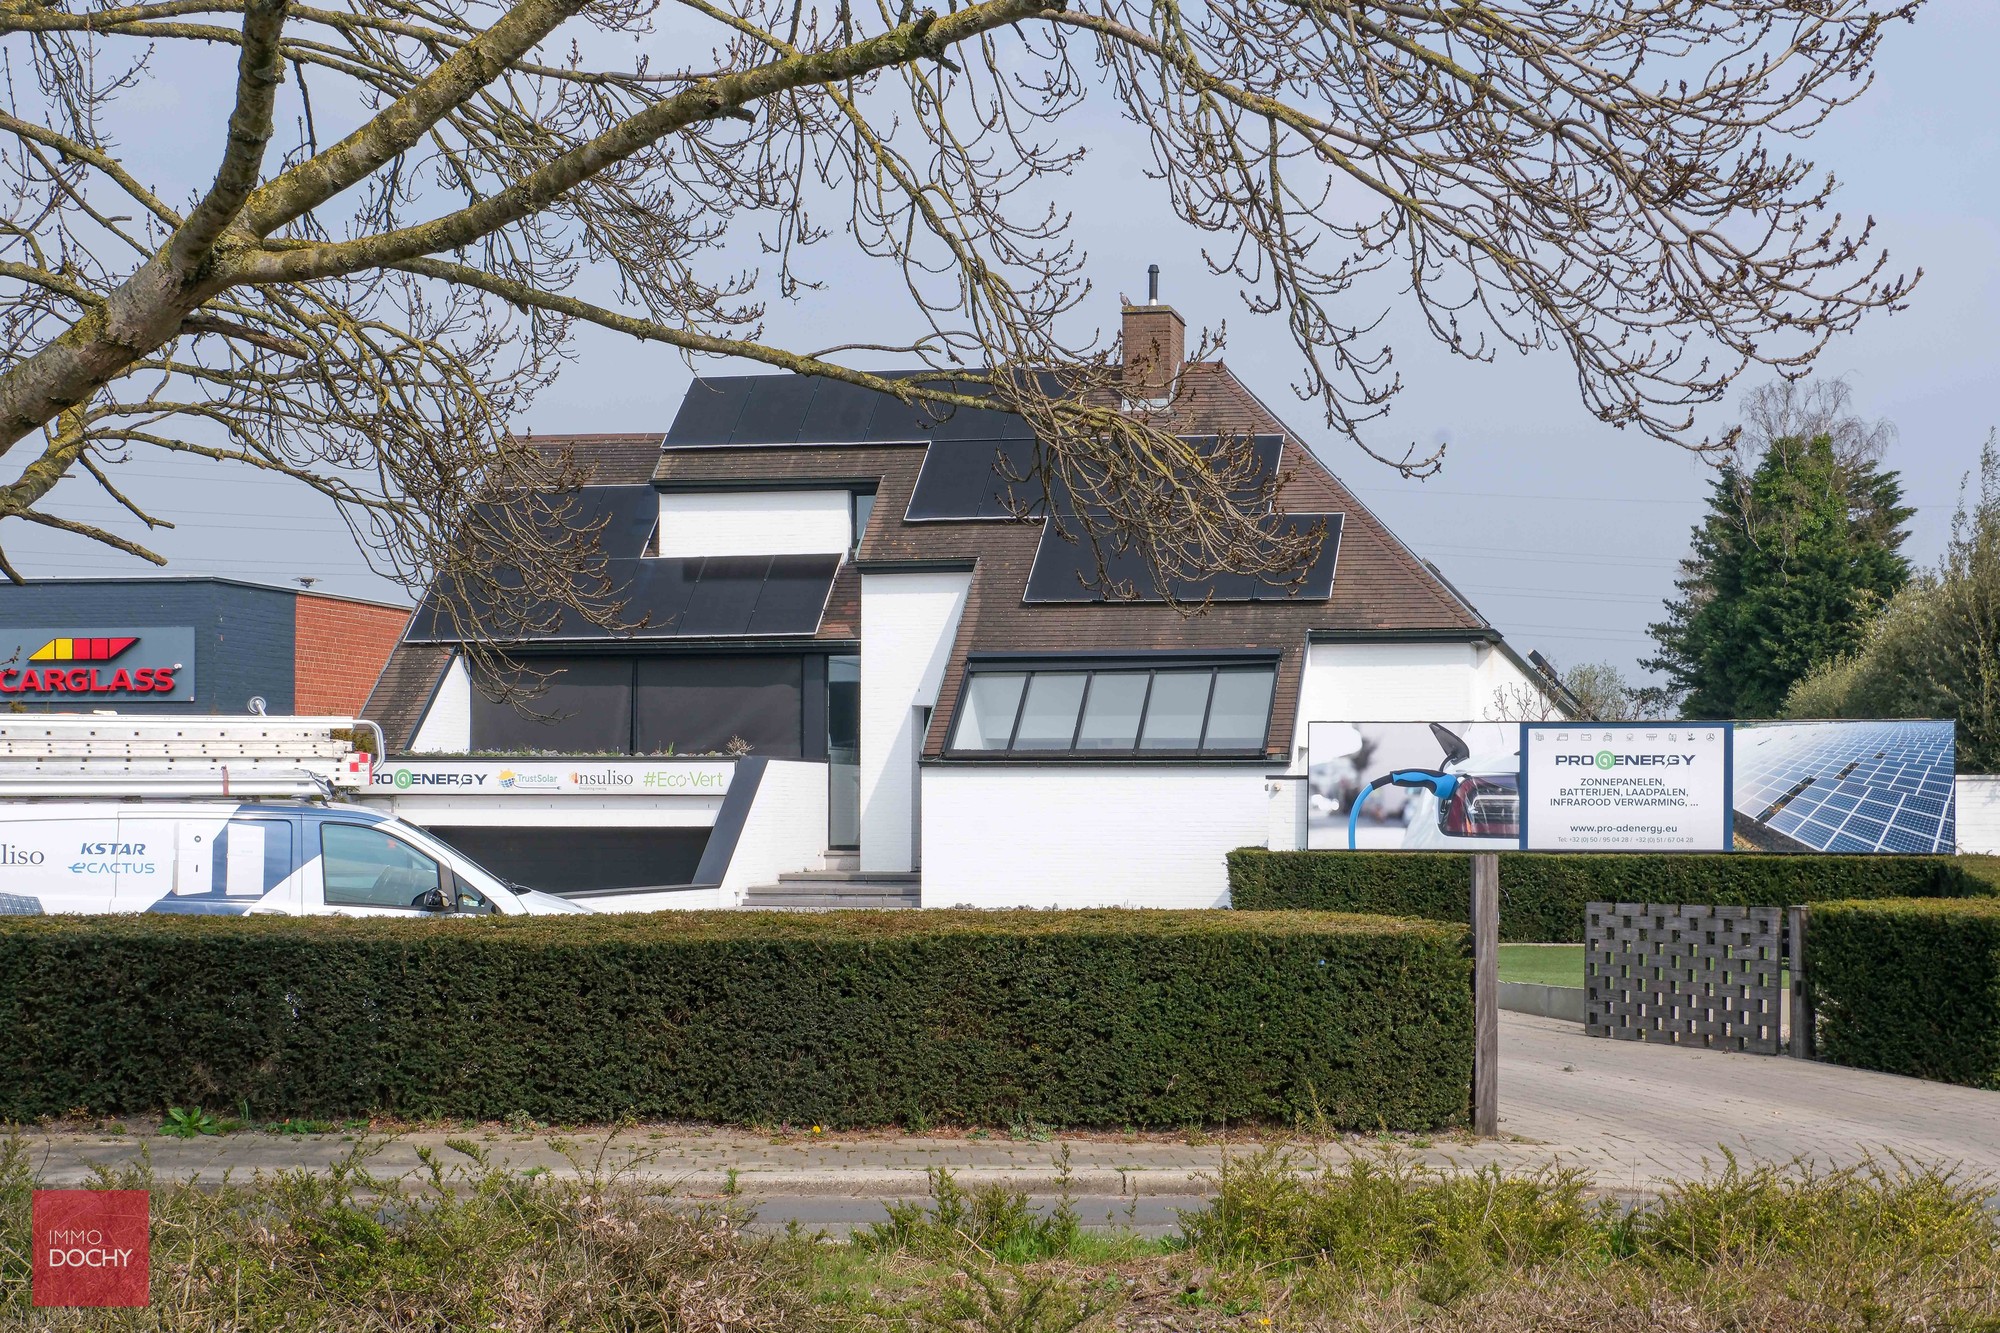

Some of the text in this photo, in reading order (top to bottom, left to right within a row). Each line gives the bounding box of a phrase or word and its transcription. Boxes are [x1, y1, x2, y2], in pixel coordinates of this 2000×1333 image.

[517, 773, 558, 783] TrustSolar
[1580, 778, 1665, 787] ZONNEPANELEN,
[1559, 788, 1689, 797] BATTERIJEN, LAADPALEN,
[1550, 798, 1611, 806] INFRAROOD
[1614, 798, 1688, 808] VERWARMING,
[1570, 824, 1678, 835] www.pro-adenergy.eu
[80, 843, 146, 855] KSTAR
